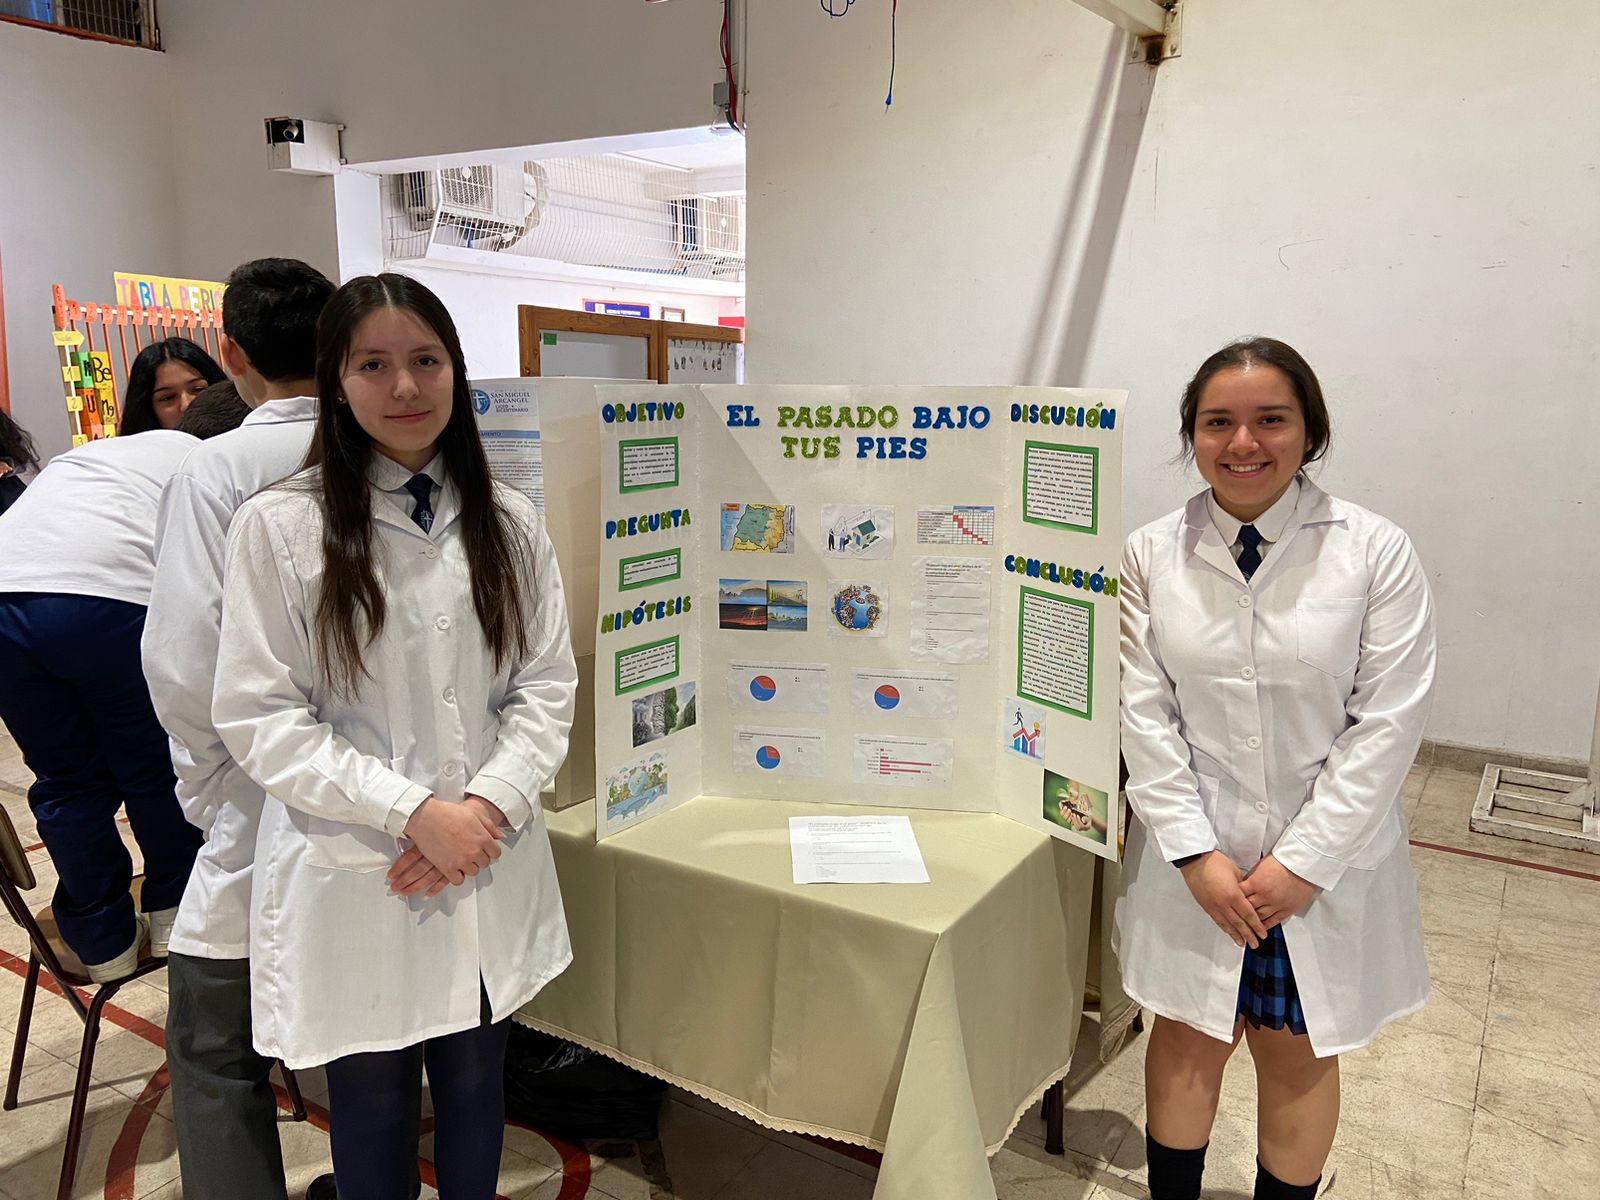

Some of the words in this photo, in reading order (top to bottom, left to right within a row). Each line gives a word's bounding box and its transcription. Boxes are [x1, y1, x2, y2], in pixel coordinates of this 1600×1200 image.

[117, 279, 174, 313] TABLA
[91, 356, 112, 383] Be
[602, 402, 685, 424] OBJETIVO
[726, 405, 760, 427] EL
[777, 405, 899, 429] PASADO
[913, 405, 991, 429] BAJO
[1010, 402, 1117, 430] DISCUSIÓN
[780, 436, 841, 459] TUS
[856, 436, 928, 460] PIES
[605, 508, 692, 539] PREGUNTA
[1004, 555, 1119, 597] CONCLUSIÓN
[601, 595, 692, 634] HIPÓTESIS
